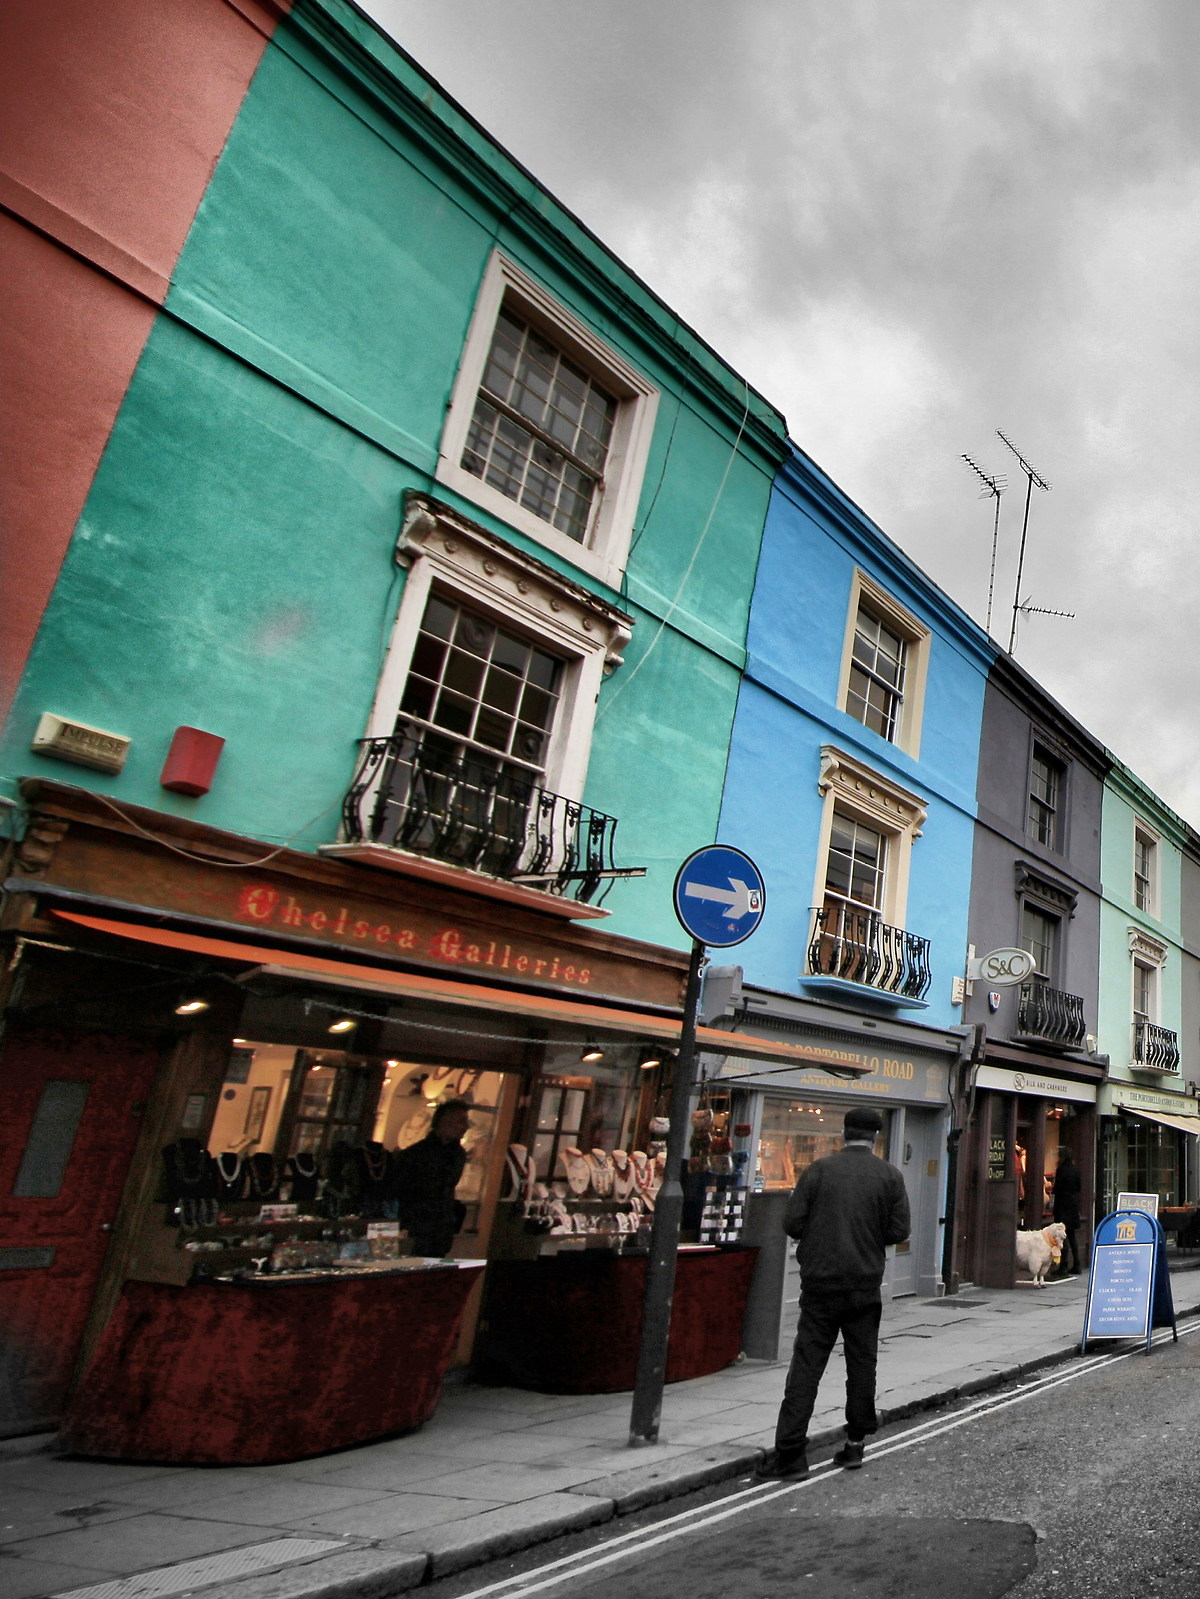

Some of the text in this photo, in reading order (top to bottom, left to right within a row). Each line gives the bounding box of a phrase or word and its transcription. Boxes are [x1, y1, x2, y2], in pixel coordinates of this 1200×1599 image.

[247, 887, 592, 985] Chelsea Galleries
[987, 955, 1024, 979] S&C
[794, 1044, 914, 1080] OBELLO ROAD
[800, 1073, 892, 1093] ANTIQUES GALLERY
[990, 1140, 1006, 1150] LACK
[989, 1151, 1006, 1162] RIDAY
[1121, 1198, 1155, 1208] BLACK
